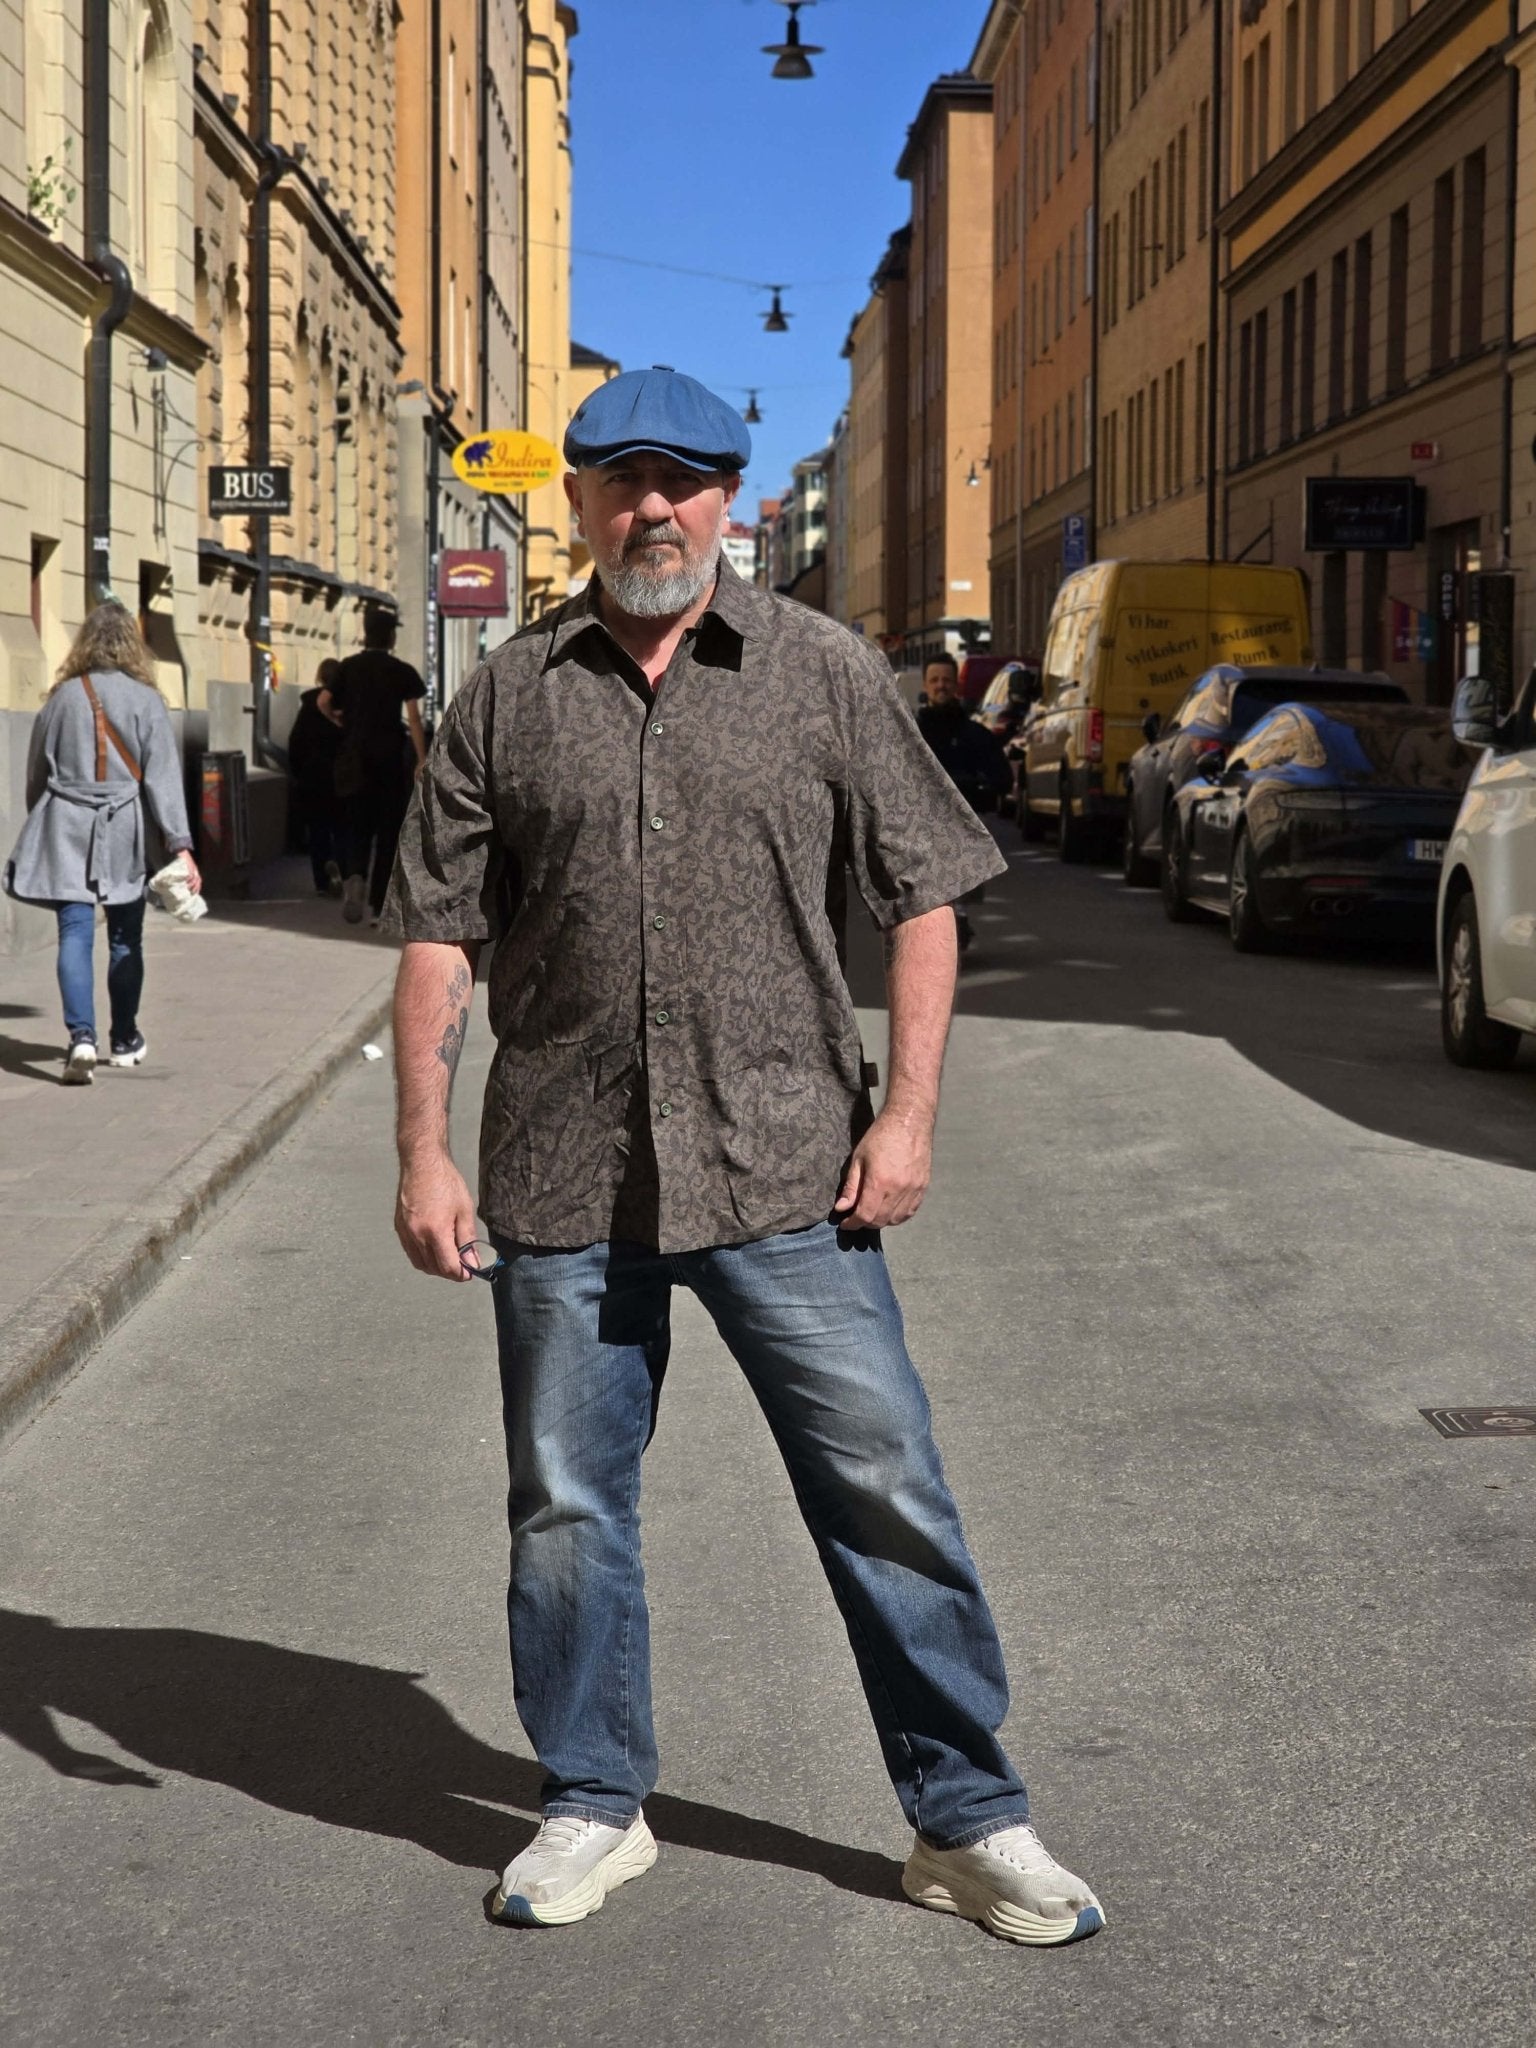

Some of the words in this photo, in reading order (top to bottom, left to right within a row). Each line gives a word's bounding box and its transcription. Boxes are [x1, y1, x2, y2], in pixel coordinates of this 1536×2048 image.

[487, 441, 552, 468] Indira
[223, 472, 275, 498] BUS
[1069, 518, 1081, 535] P
[1128, 614, 1142, 629] Vi
[1210, 619, 1293, 645] Restaurang
[1125, 635, 1199, 666] Syltkokeri
[1233, 650, 1267, 666] Rum
[1148, 663, 1188, 686] Butik
